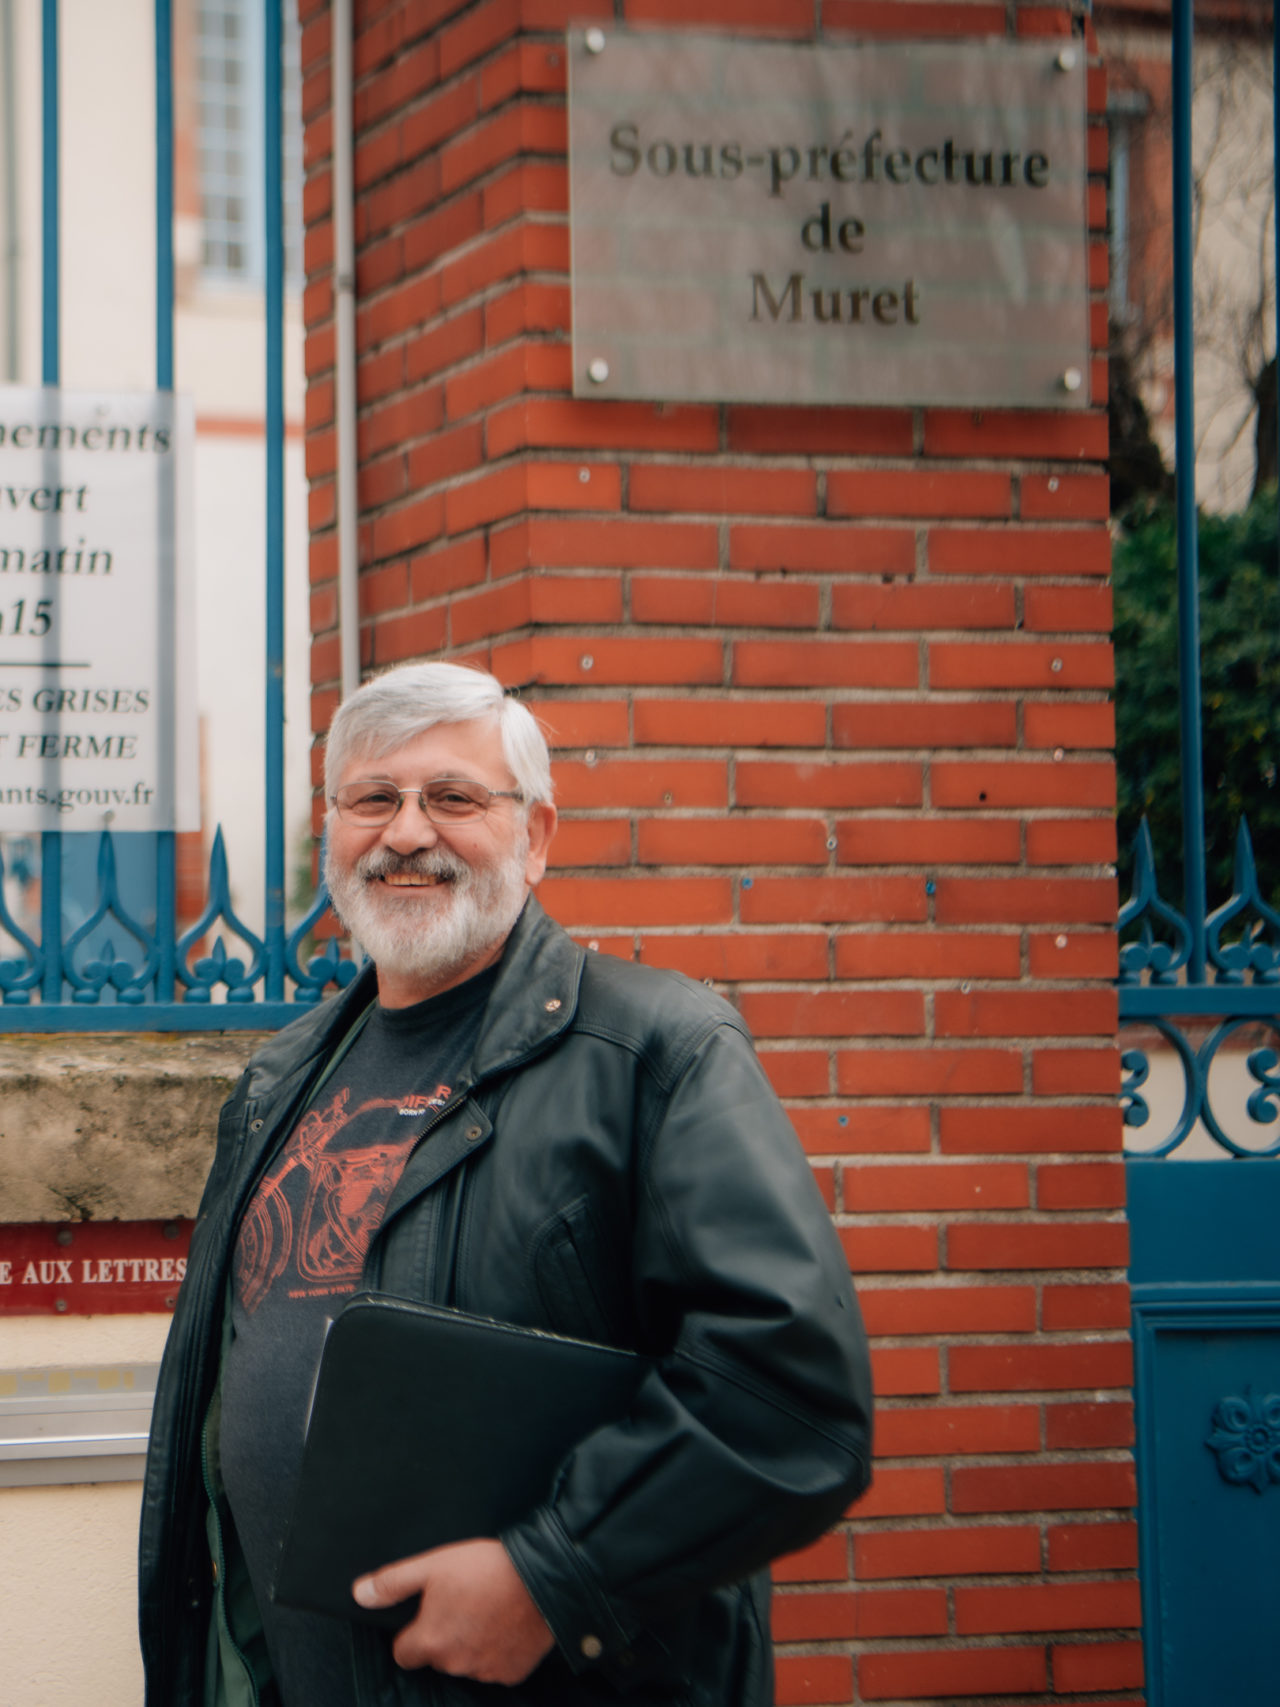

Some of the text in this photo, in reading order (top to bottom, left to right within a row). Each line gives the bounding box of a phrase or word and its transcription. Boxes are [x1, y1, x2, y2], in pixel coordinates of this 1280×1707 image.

[609, 122, 1049, 197] Sous-préfecture
[800, 203, 865, 254] de
[747, 272, 920, 326] Muret
[31, 687, 152, 714] GRISES
[15, 733, 140, 760] FERME
[21, 1259, 74, 1285] AUX
[81, 1257, 188, 1283] LETTRES
